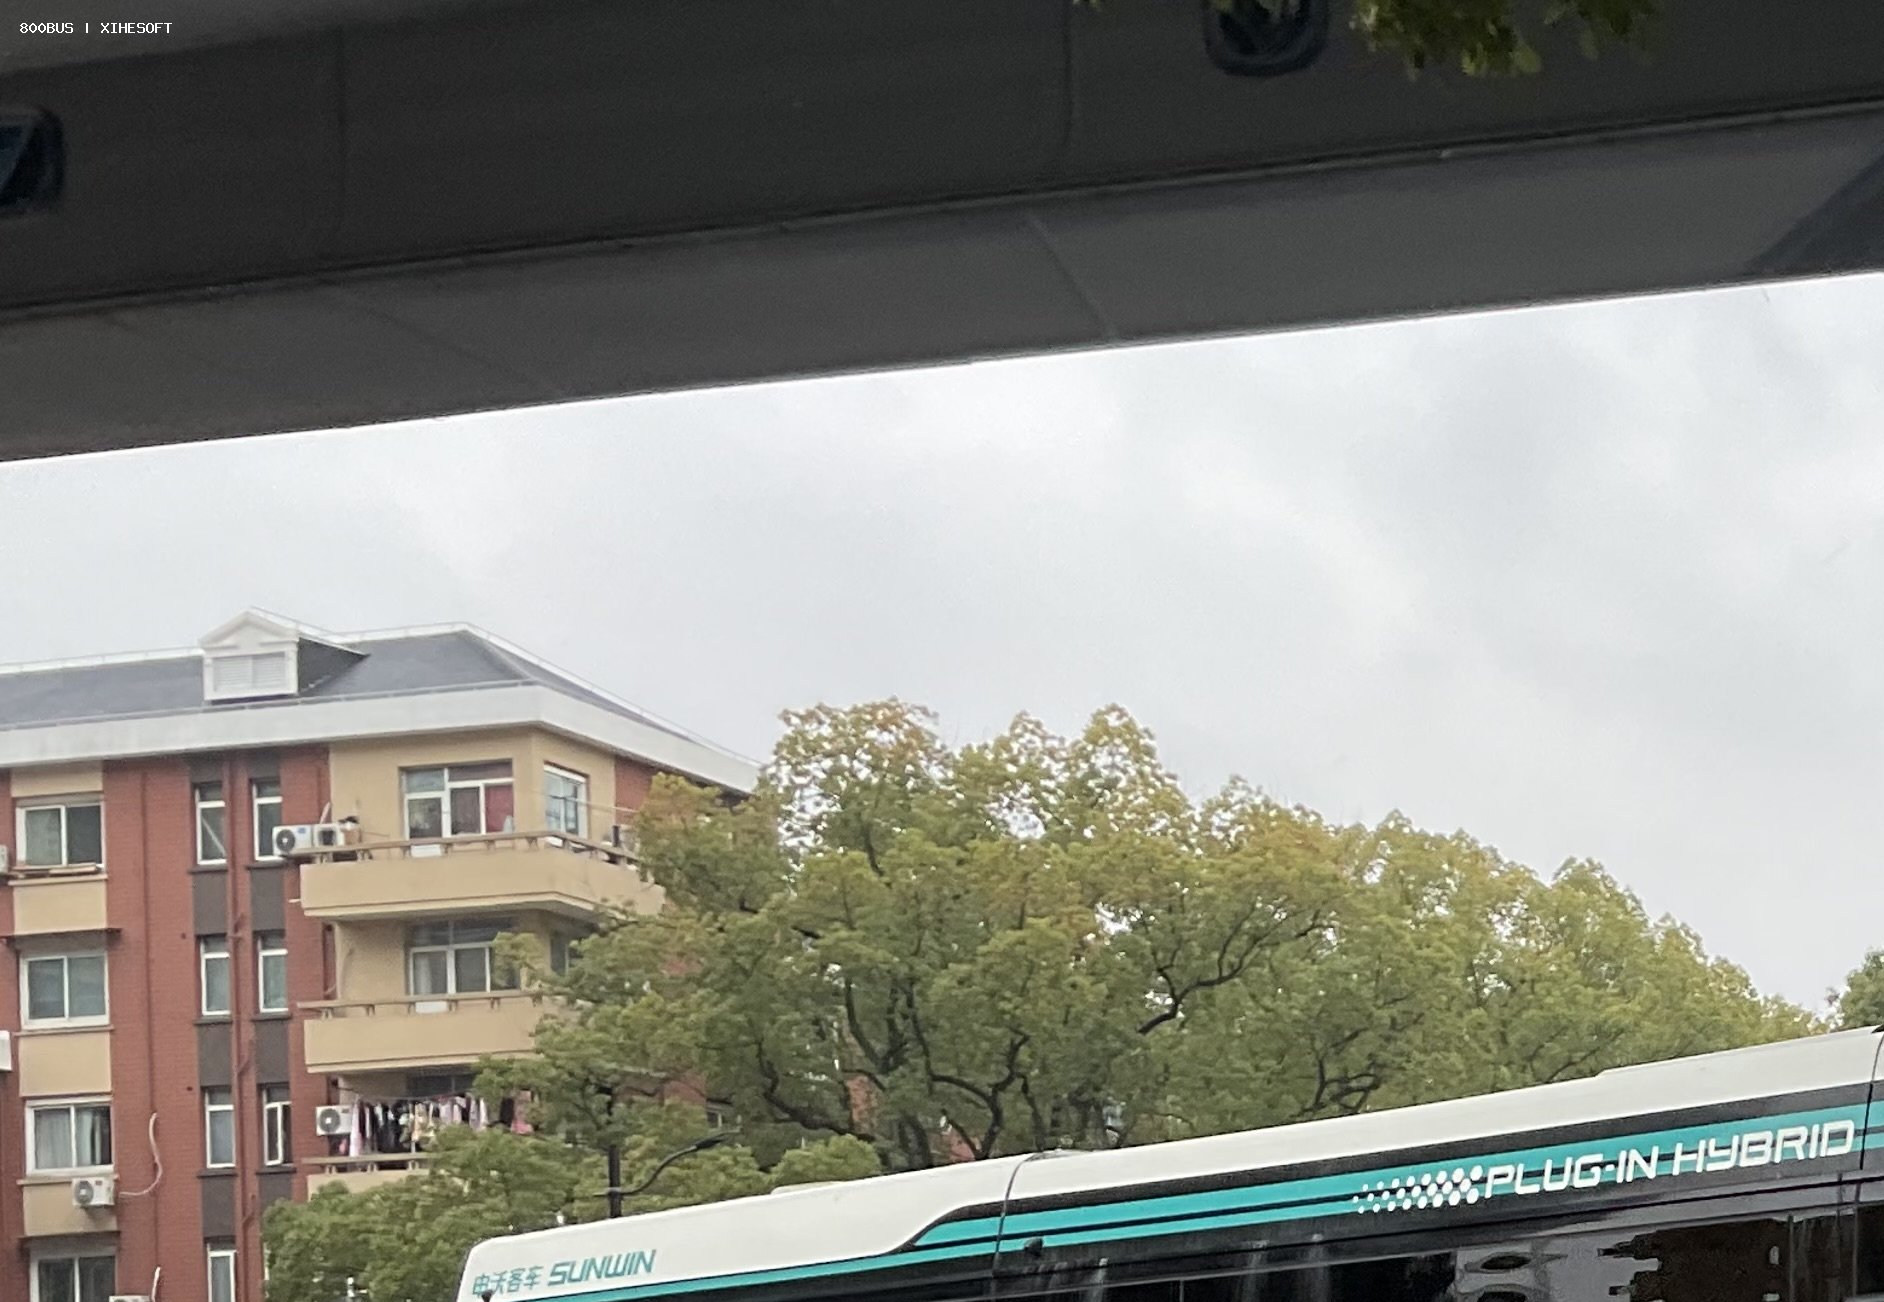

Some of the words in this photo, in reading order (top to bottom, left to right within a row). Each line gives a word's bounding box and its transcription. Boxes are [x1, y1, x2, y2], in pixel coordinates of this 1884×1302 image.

[1483, 1146, 1658, 1199] PLUG-IN
[1671, 1119, 1855, 1175] HYBRID
[548, 1249, 656, 1286] SUNWIN
